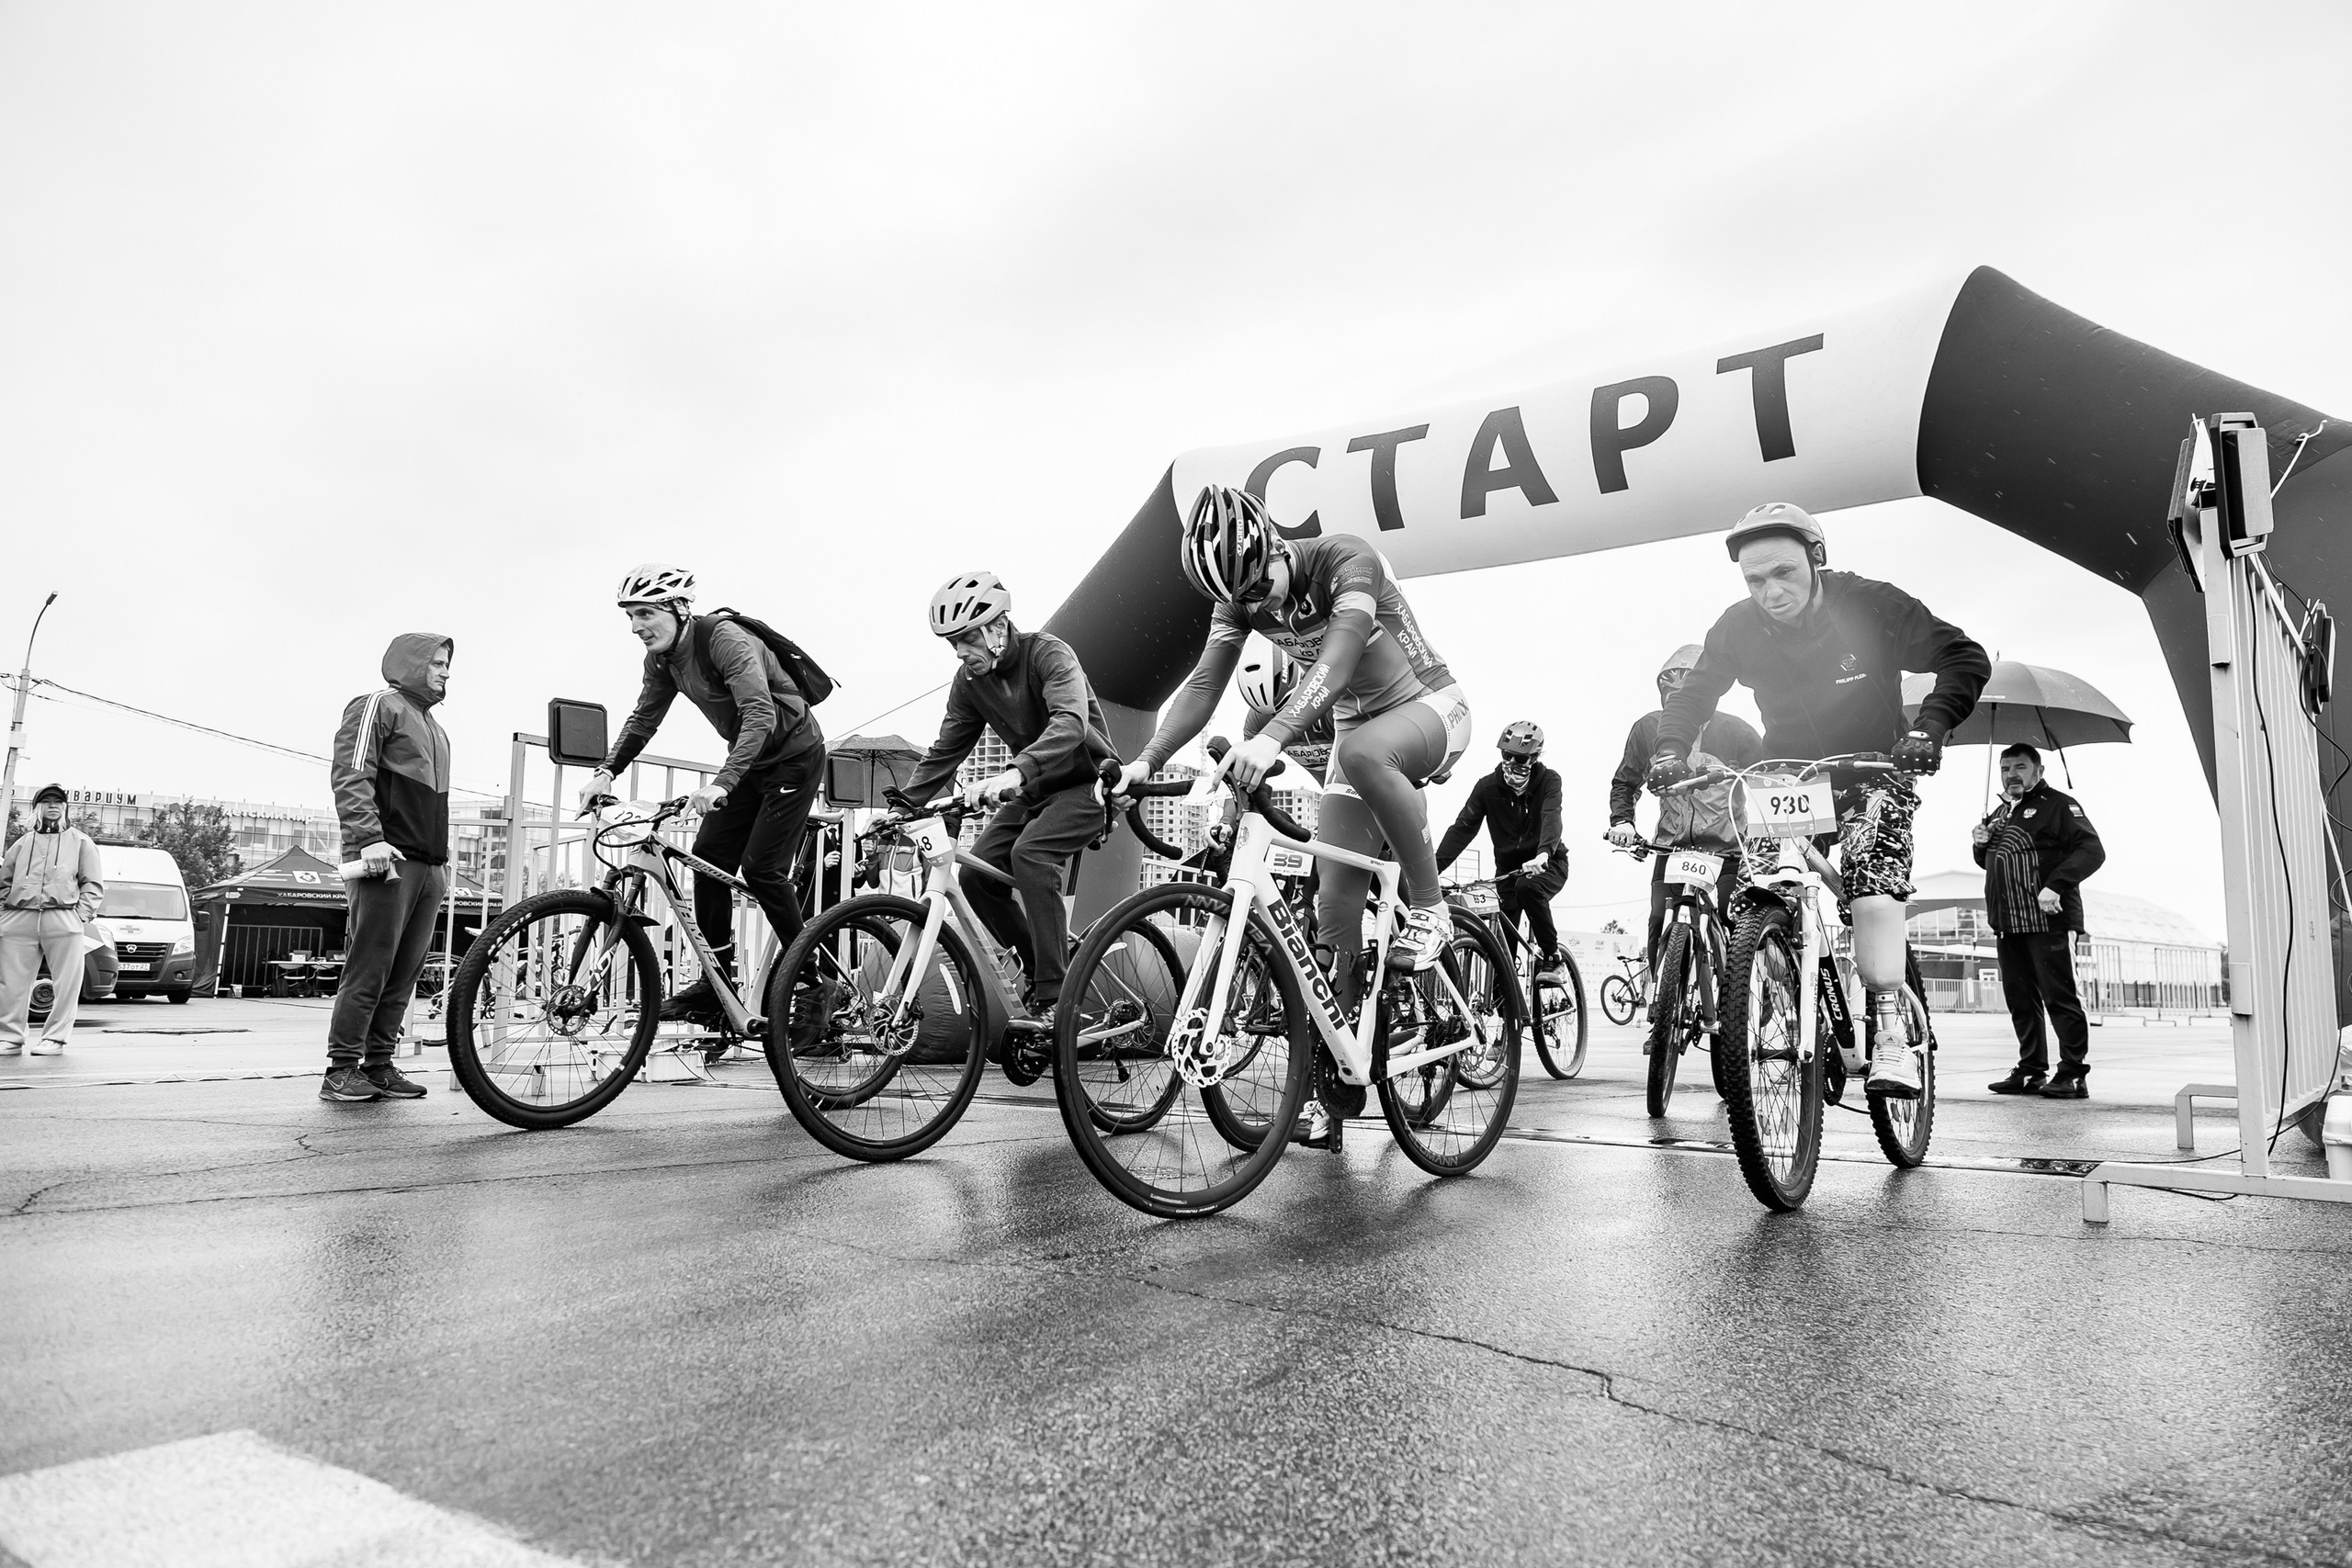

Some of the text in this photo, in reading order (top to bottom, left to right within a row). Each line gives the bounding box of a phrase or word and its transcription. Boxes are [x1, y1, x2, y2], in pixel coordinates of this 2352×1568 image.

[1244, 333, 1824, 540] СТАРТ
[1271, 635, 1324, 649] АБАРОВ
[1395, 602, 1433, 668] ХАБАРОВСКИЙ
[1396, 629, 1419, 660] КРАЙ
[1288, 663, 1331, 717] ХАБАРОВСКИЙ
[1310, 684, 1331, 710] КРАЙ
[1287, 748, 1332, 758] АБАРОВС
[64, 790, 137, 806] квариум
[1770, 795, 1810, 816] 930
[1273, 852, 1304, 869] 39
[1681, 861, 1707, 875] 860
[1267, 898, 1346, 1031] Bianchi
[1820, 967, 1843, 1021] CRONUS
